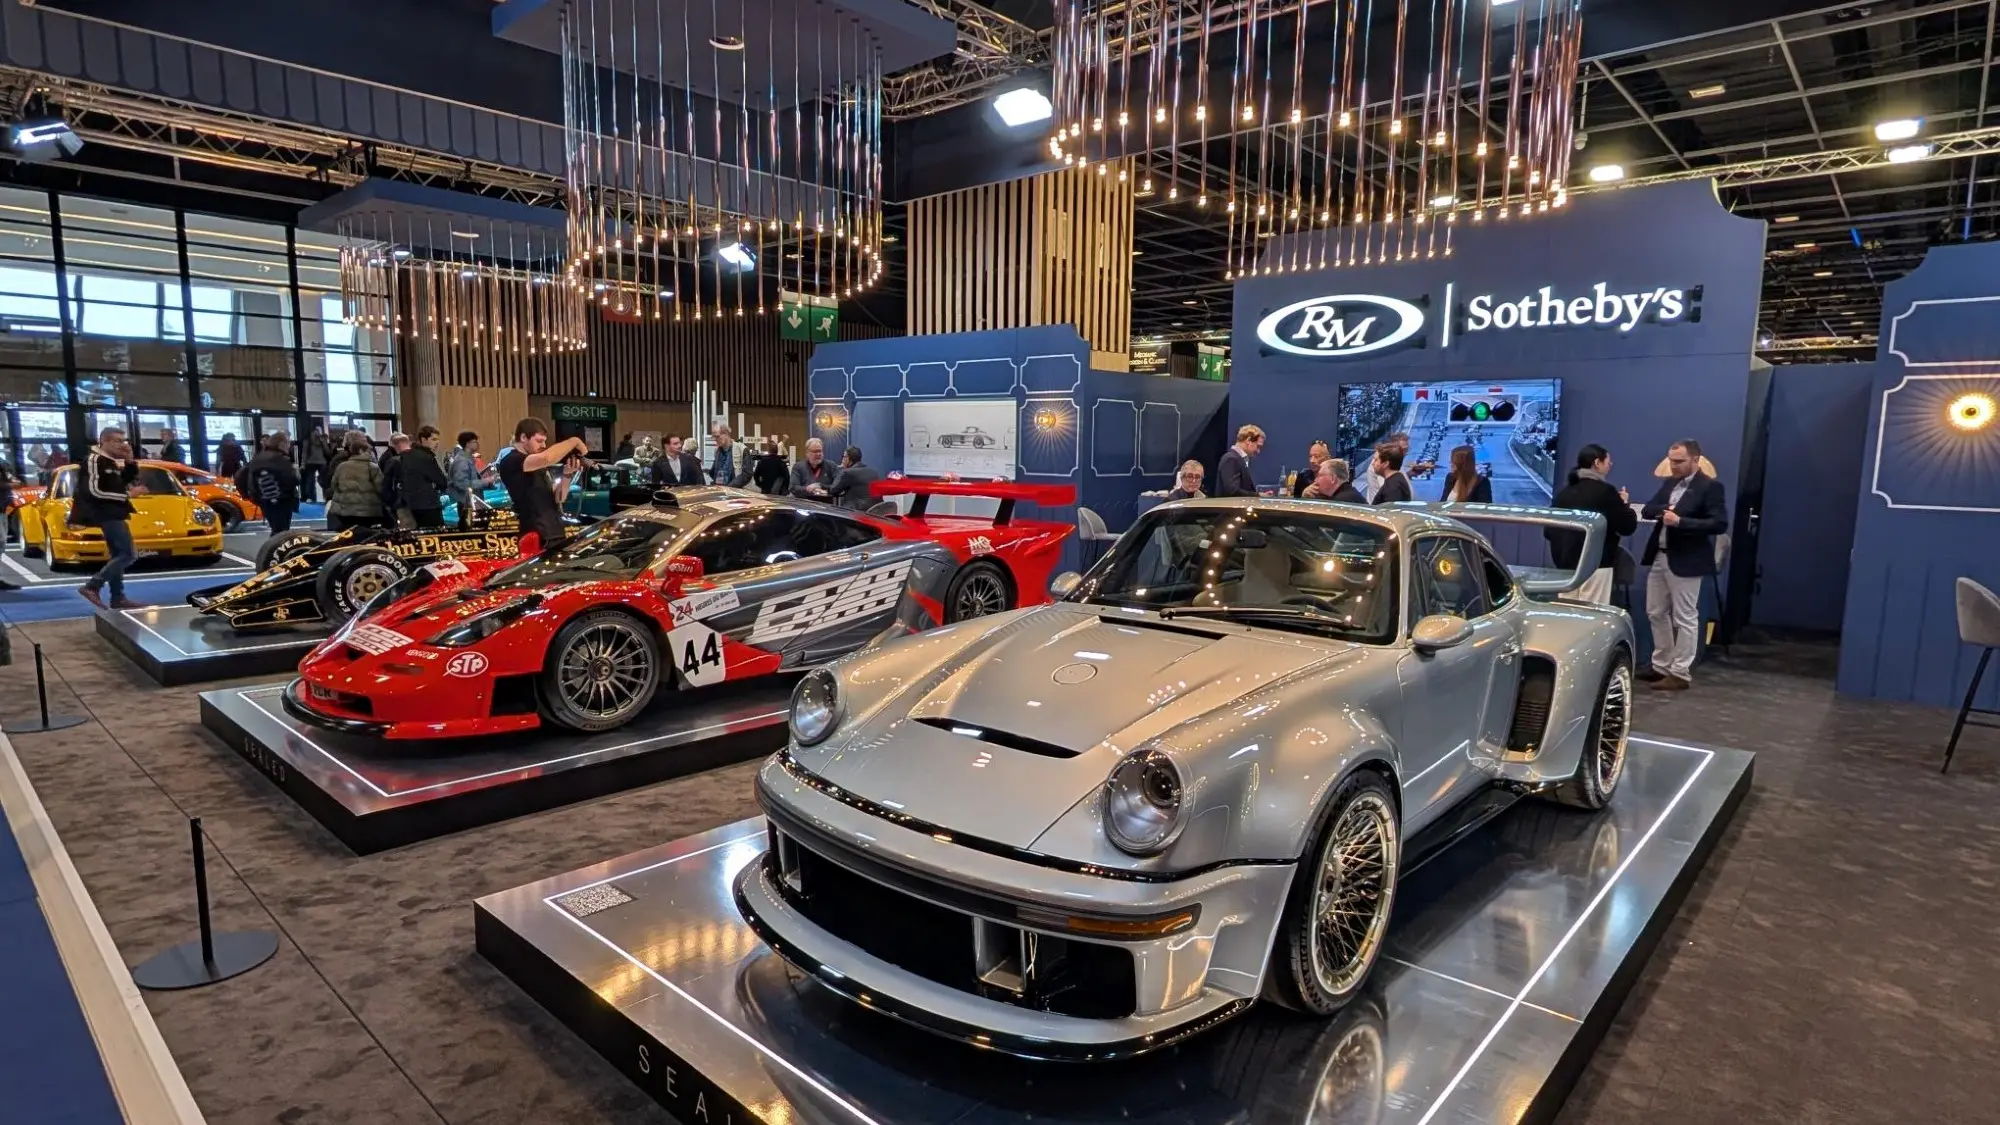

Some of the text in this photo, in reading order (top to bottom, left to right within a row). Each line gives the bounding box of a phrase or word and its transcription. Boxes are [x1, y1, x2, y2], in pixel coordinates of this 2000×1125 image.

[1292, 282, 1685, 348] RM Sotheby's
[375, 362, 387, 376] 7
[562, 404, 608, 418] SORTIE
[418, 536, 482, 555] Player
[334, 580, 351, 613] EAGLE
[451, 653, 484, 673] STP
[683, 632, 721, 676] 44
